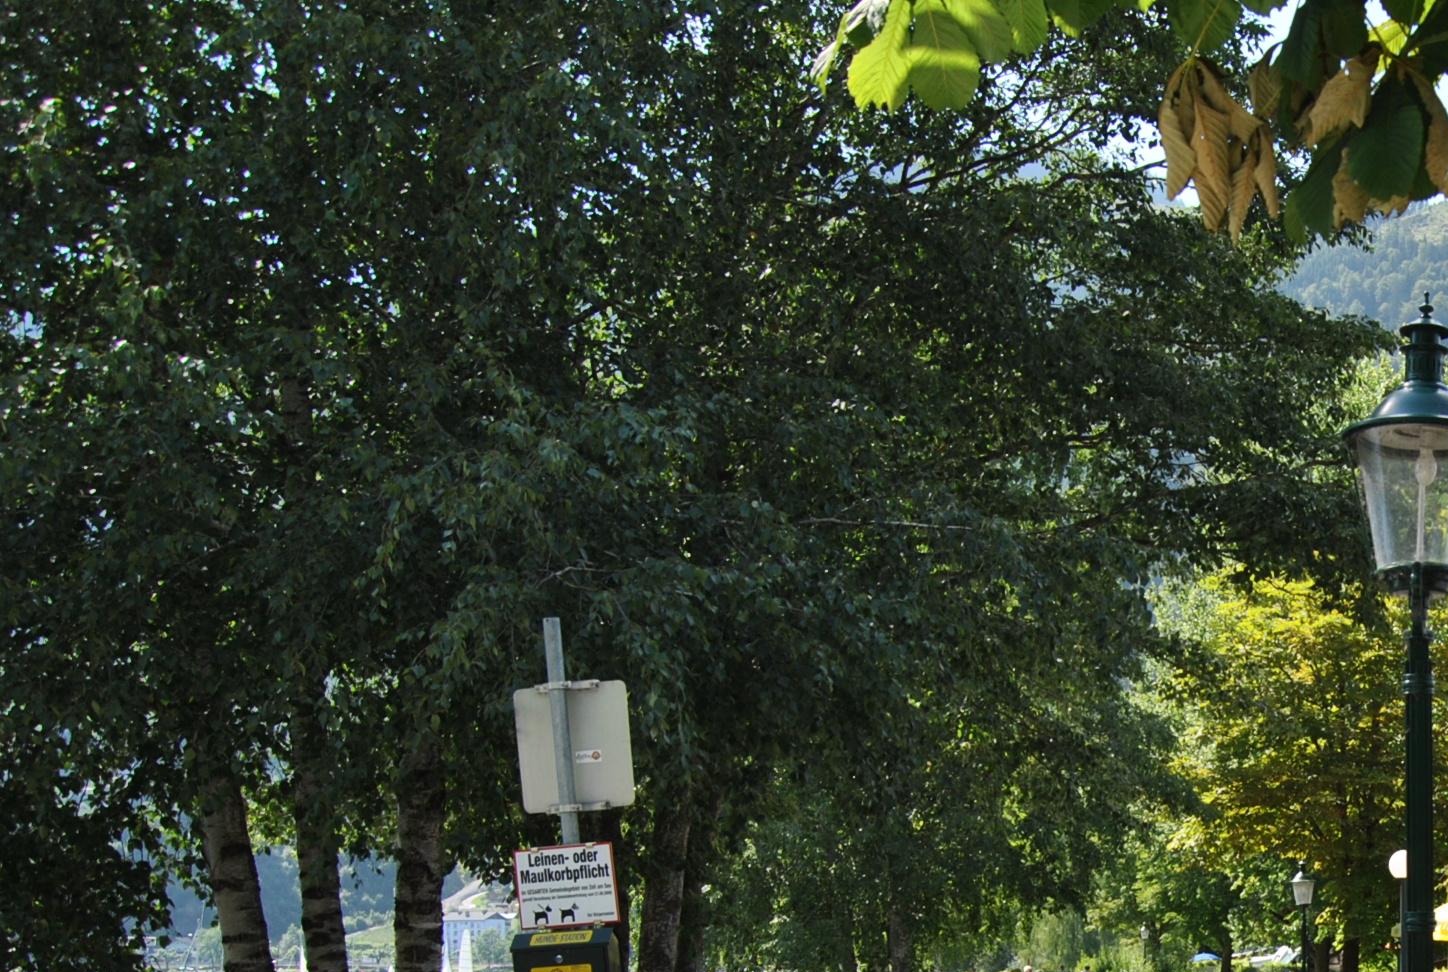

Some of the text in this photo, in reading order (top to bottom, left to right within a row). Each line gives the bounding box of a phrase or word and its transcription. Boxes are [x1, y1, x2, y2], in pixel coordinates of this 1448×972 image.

[527, 849, 598, 868] Leinen- oder
[520, 863, 610, 885] Maulkorbpflicht
